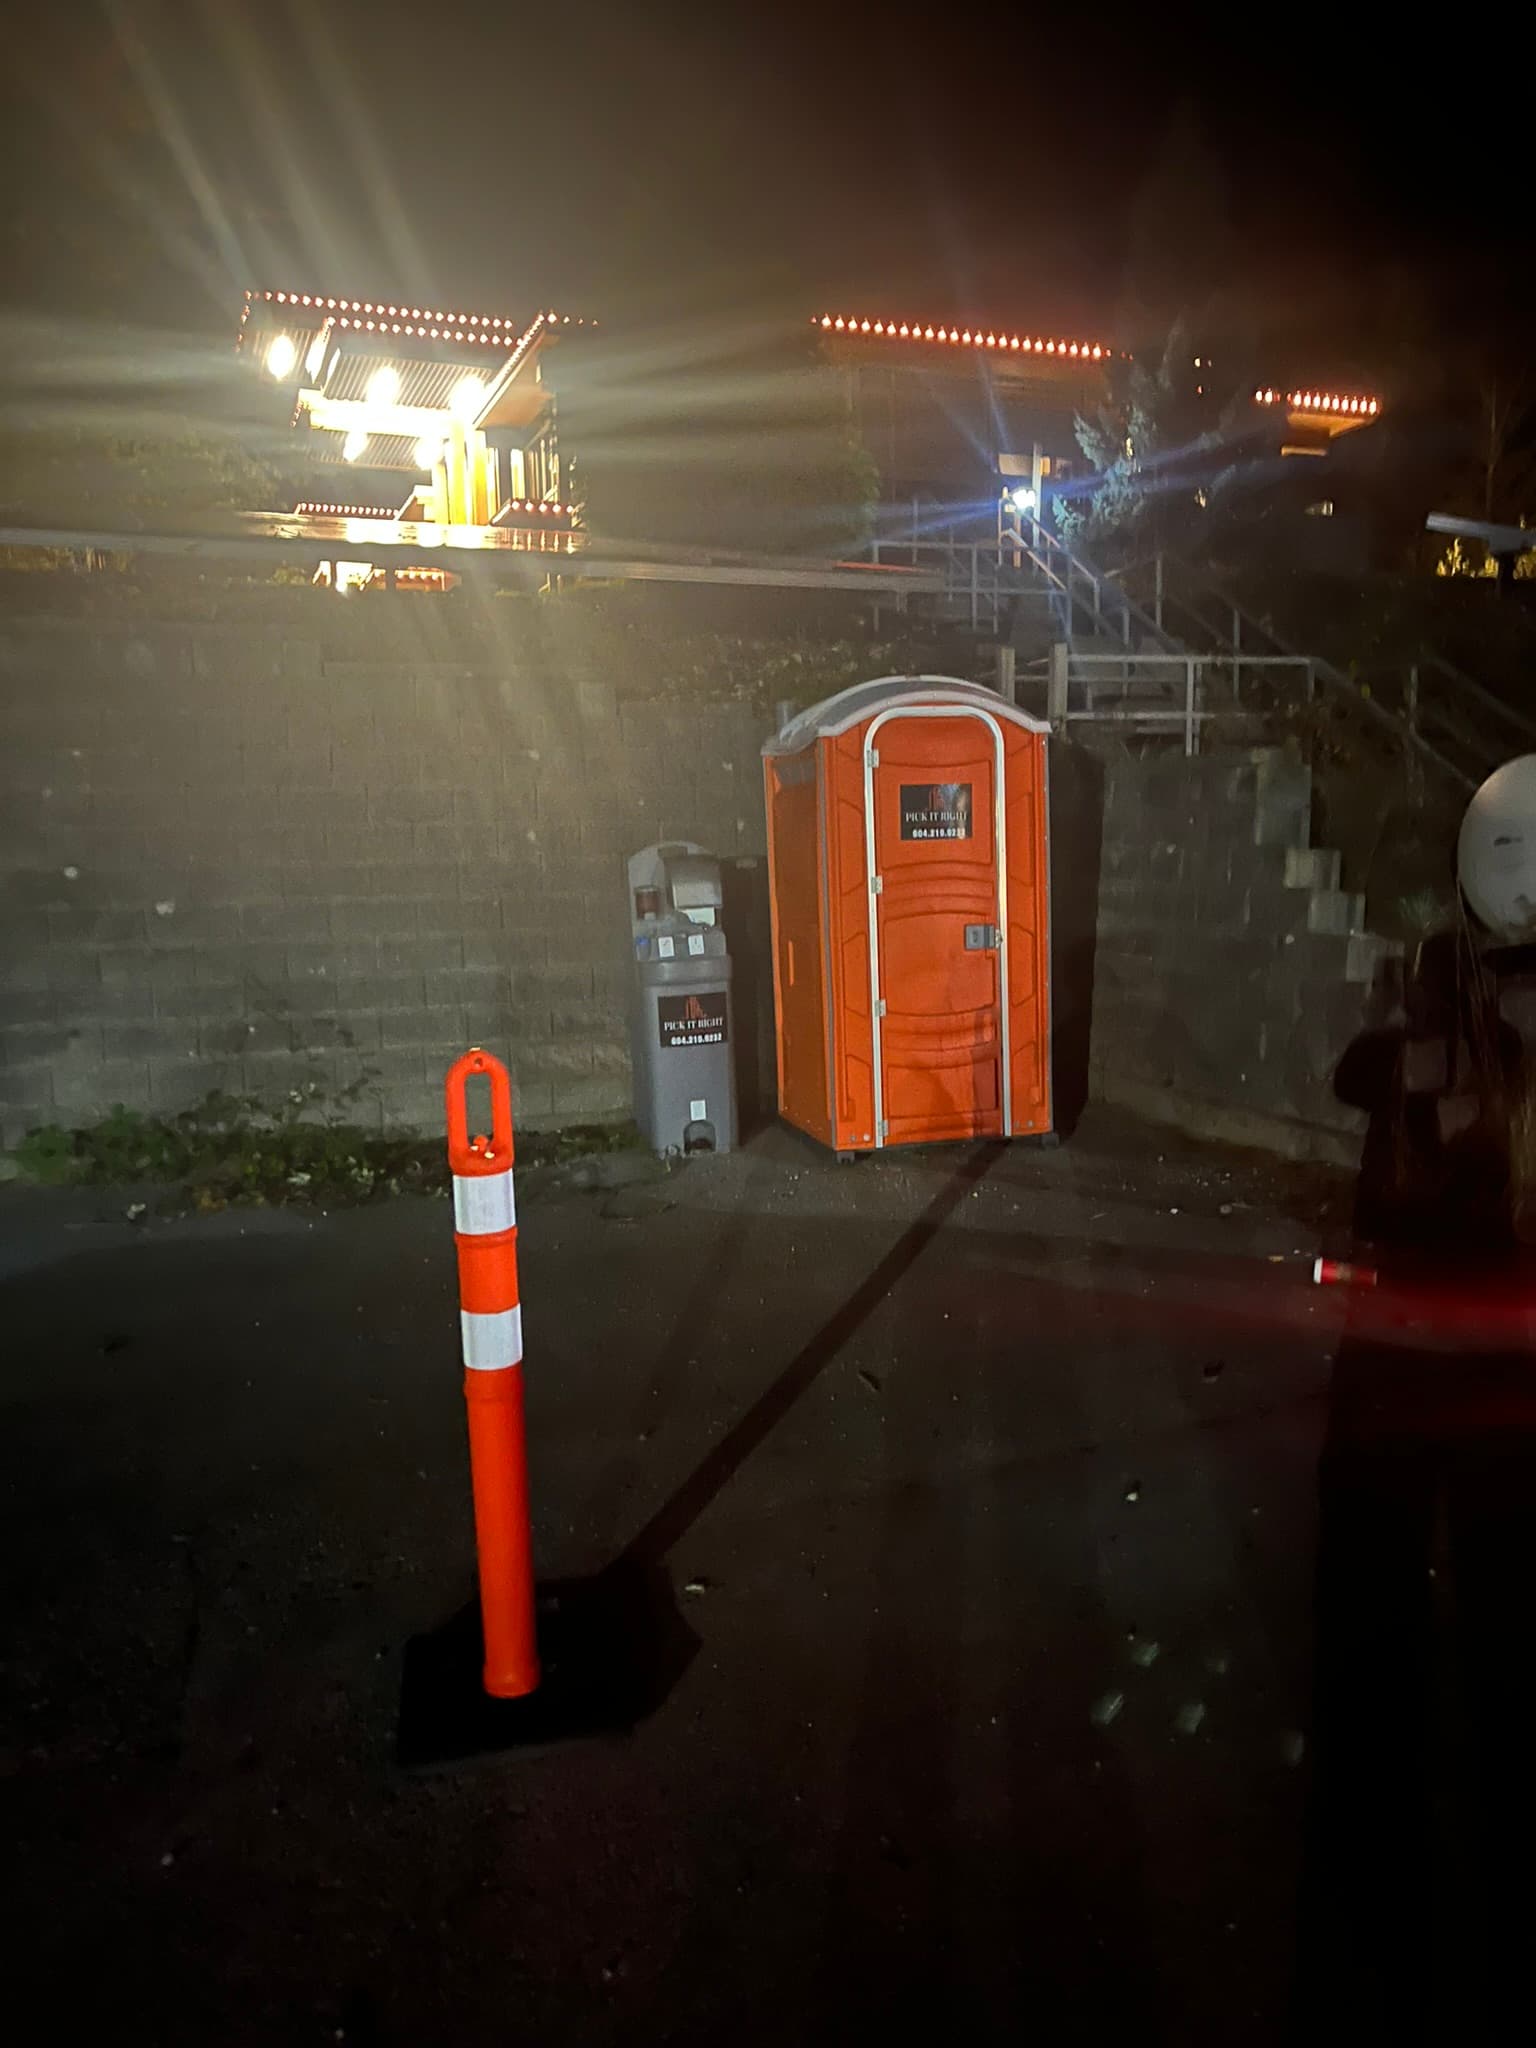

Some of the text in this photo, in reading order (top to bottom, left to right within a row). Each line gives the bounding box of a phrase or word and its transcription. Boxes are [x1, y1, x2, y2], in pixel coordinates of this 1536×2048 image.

[905, 811, 967, 822] PICK IT RIGHT
[664, 1017, 723, 1031] PICK IT RIGHT
